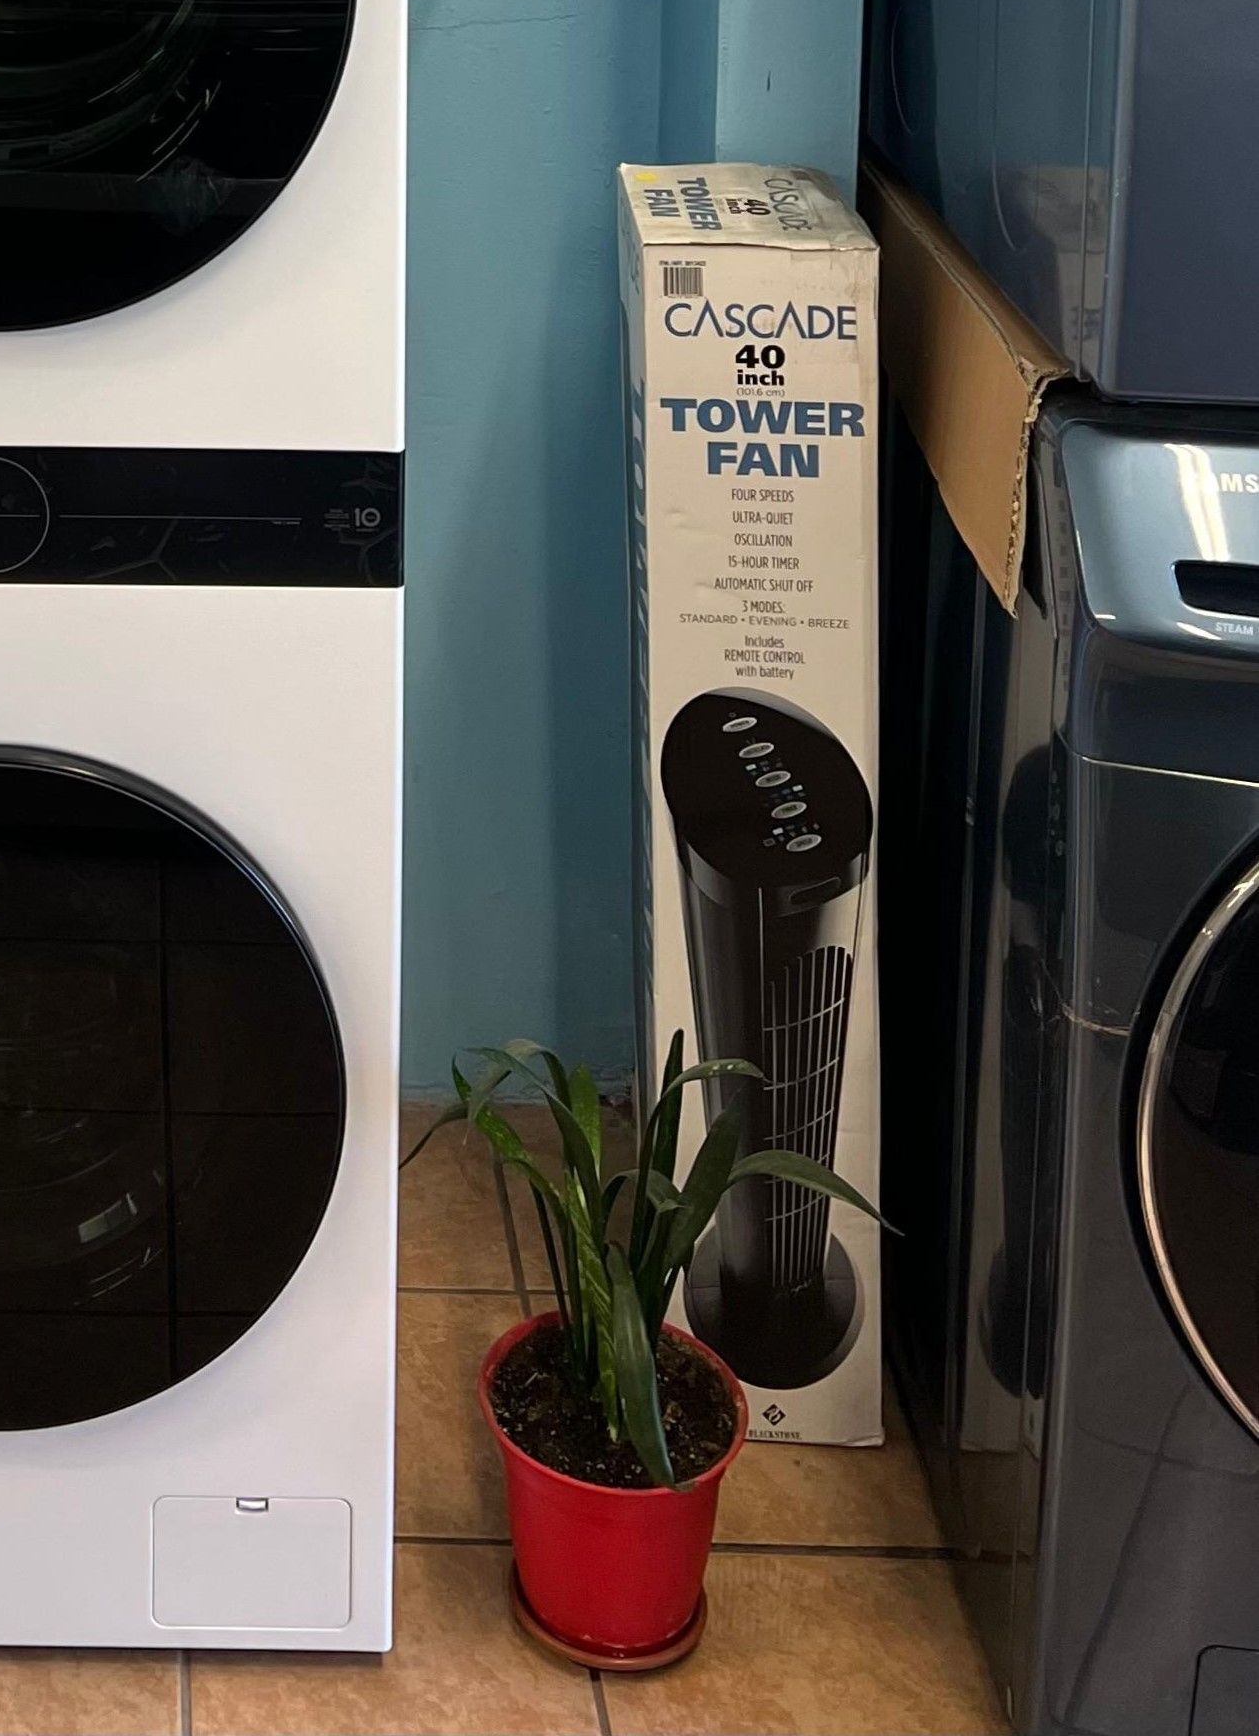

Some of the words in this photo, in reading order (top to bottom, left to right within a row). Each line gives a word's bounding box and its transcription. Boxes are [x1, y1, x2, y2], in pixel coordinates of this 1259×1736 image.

[644, 189, 682, 217] FAN
[677, 177, 723, 231] TOWER
[744, 198, 772, 216] 40
[664, 300, 857, 340] CASCADE
[735, 344, 786, 370] 40
[737, 370, 784, 386] inch
[736, 387, 763, 397] (101.6
[765, 388, 785, 398] cm)
[660, 398, 866, 437] TOWER
[707, 440, 820, 478] FAN
[731, 488, 756, 502] FOUR
[759, 489, 794, 502] SPEEDS
[732, 511, 794, 525] ULTRA-QUIET
[734, 533, 793, 547] OSCILLATION
[728, 555, 770, 570] 15-HOUR
[772, 556, 800, 570] TIMER
[714, 577, 767, 591] AUTOMATIC
[769, 578, 794, 592] SHUT
[796, 580, 814, 592] OFF
[742, 600, 748, 613] 3
[679, 614, 738, 624] STANDARD
[749, 616, 797, 627] EVENING
[808, 618, 850, 629] BREEZE
[744, 635, 784, 648] Includes
[724, 650, 760, 662] REMOTE
[763, 650, 806, 664] CONTROL
[736, 665, 757, 677] with
[759, 665, 794, 680] battery
